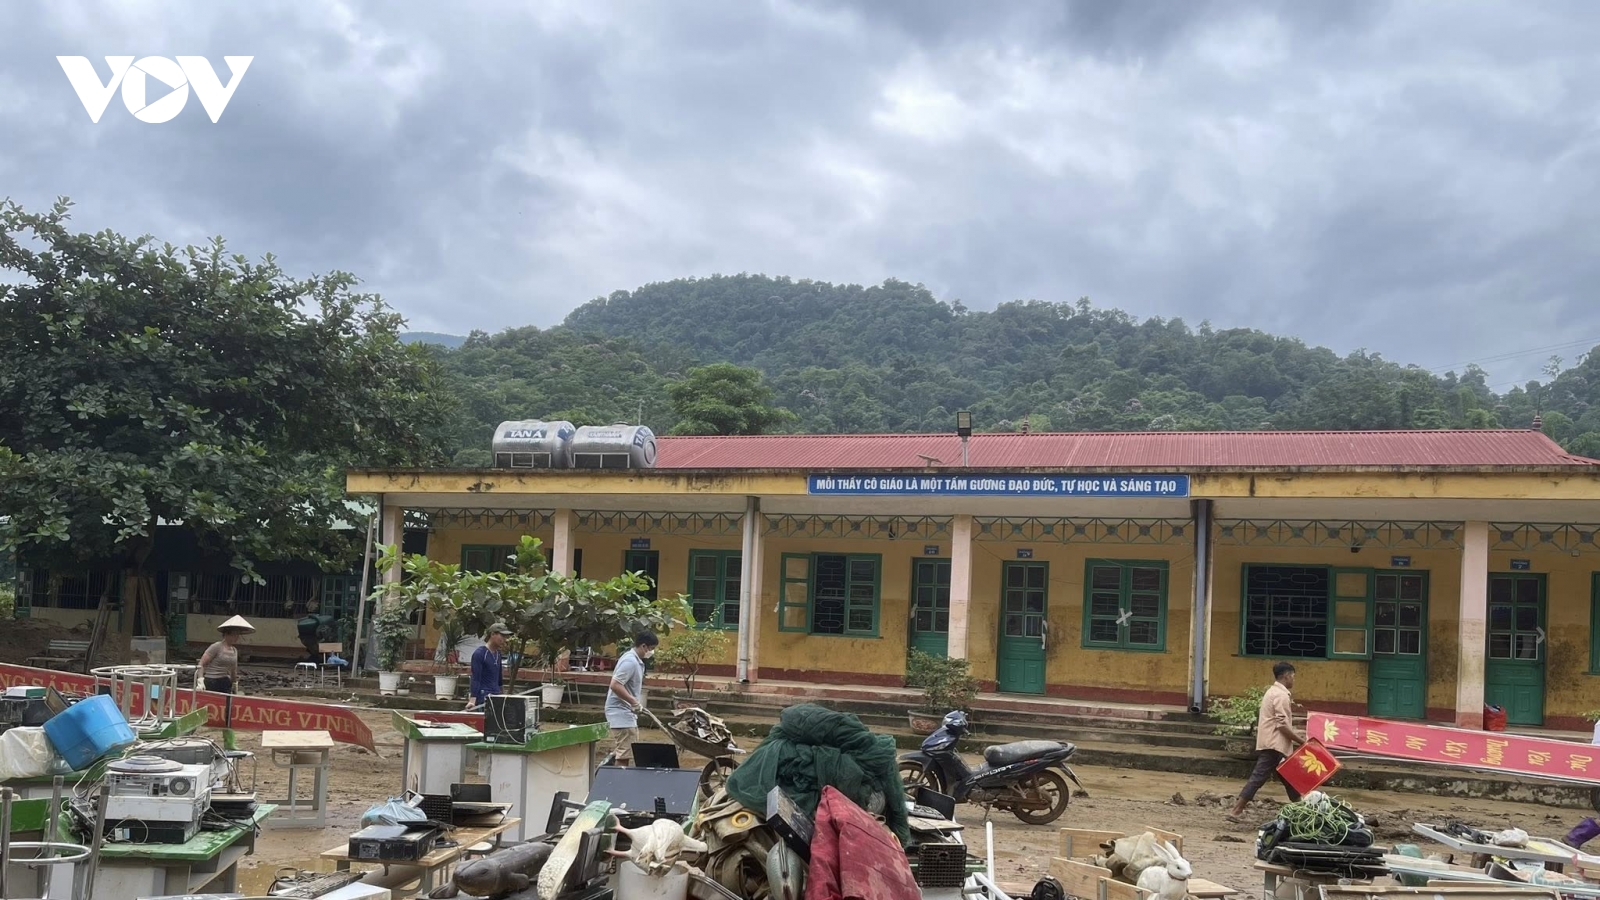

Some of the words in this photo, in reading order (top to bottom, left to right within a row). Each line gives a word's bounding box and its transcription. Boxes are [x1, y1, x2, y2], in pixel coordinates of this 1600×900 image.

[510, 429, 542, 438] TANA
[864, 476, 878, 490] CÔ
[880, 476, 904, 490] GIÁO
[906, 476, 919, 490] LÀ
[921, 477, 943, 493] MỘT
[945, 475, 968, 491] TẤM
[970, 477, 1006, 491] GƯƠNG
[1008, 479, 1031, 493] ĐẠO
[1033, 477, 1059, 493] ĐỨC,
[1061, 479, 1077, 494] TỰ
[1077, 480, 1100, 494] HỌC
[1103, 478, 1118, 492] VÀ
[1120, 478, 1152, 492] SÁNG
[1155, 480, 1177, 494] TẠO
